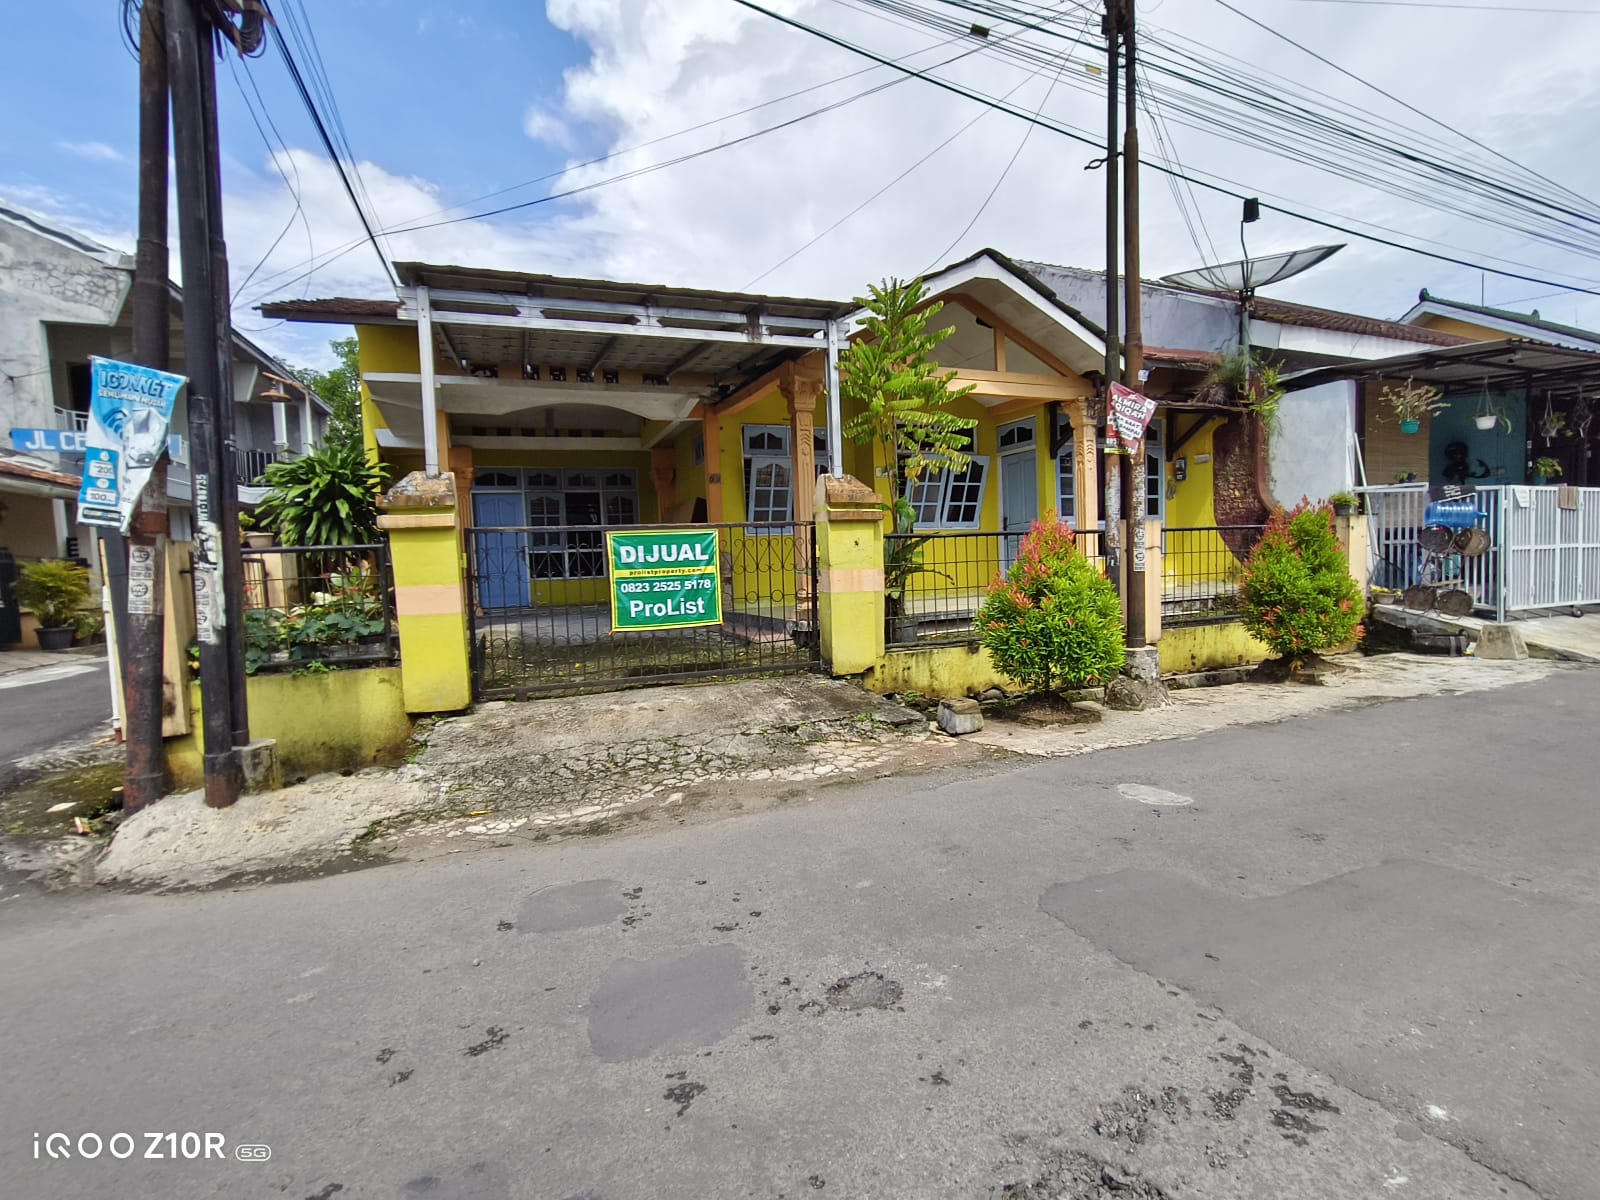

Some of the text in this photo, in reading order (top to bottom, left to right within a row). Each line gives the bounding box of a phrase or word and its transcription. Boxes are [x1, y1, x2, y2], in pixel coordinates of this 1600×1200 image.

[99, 369, 166, 398] ICONNET
[1112, 394, 1147, 413] ALMIRA
[25, 431, 56, 450] JL
[620, 544, 709, 563] DIJUAL
[629, 568, 703, 576] prolistproperty.com
[621, 579, 711, 593] 0823 2525 5178
[629, 597, 705, 617] ProList
